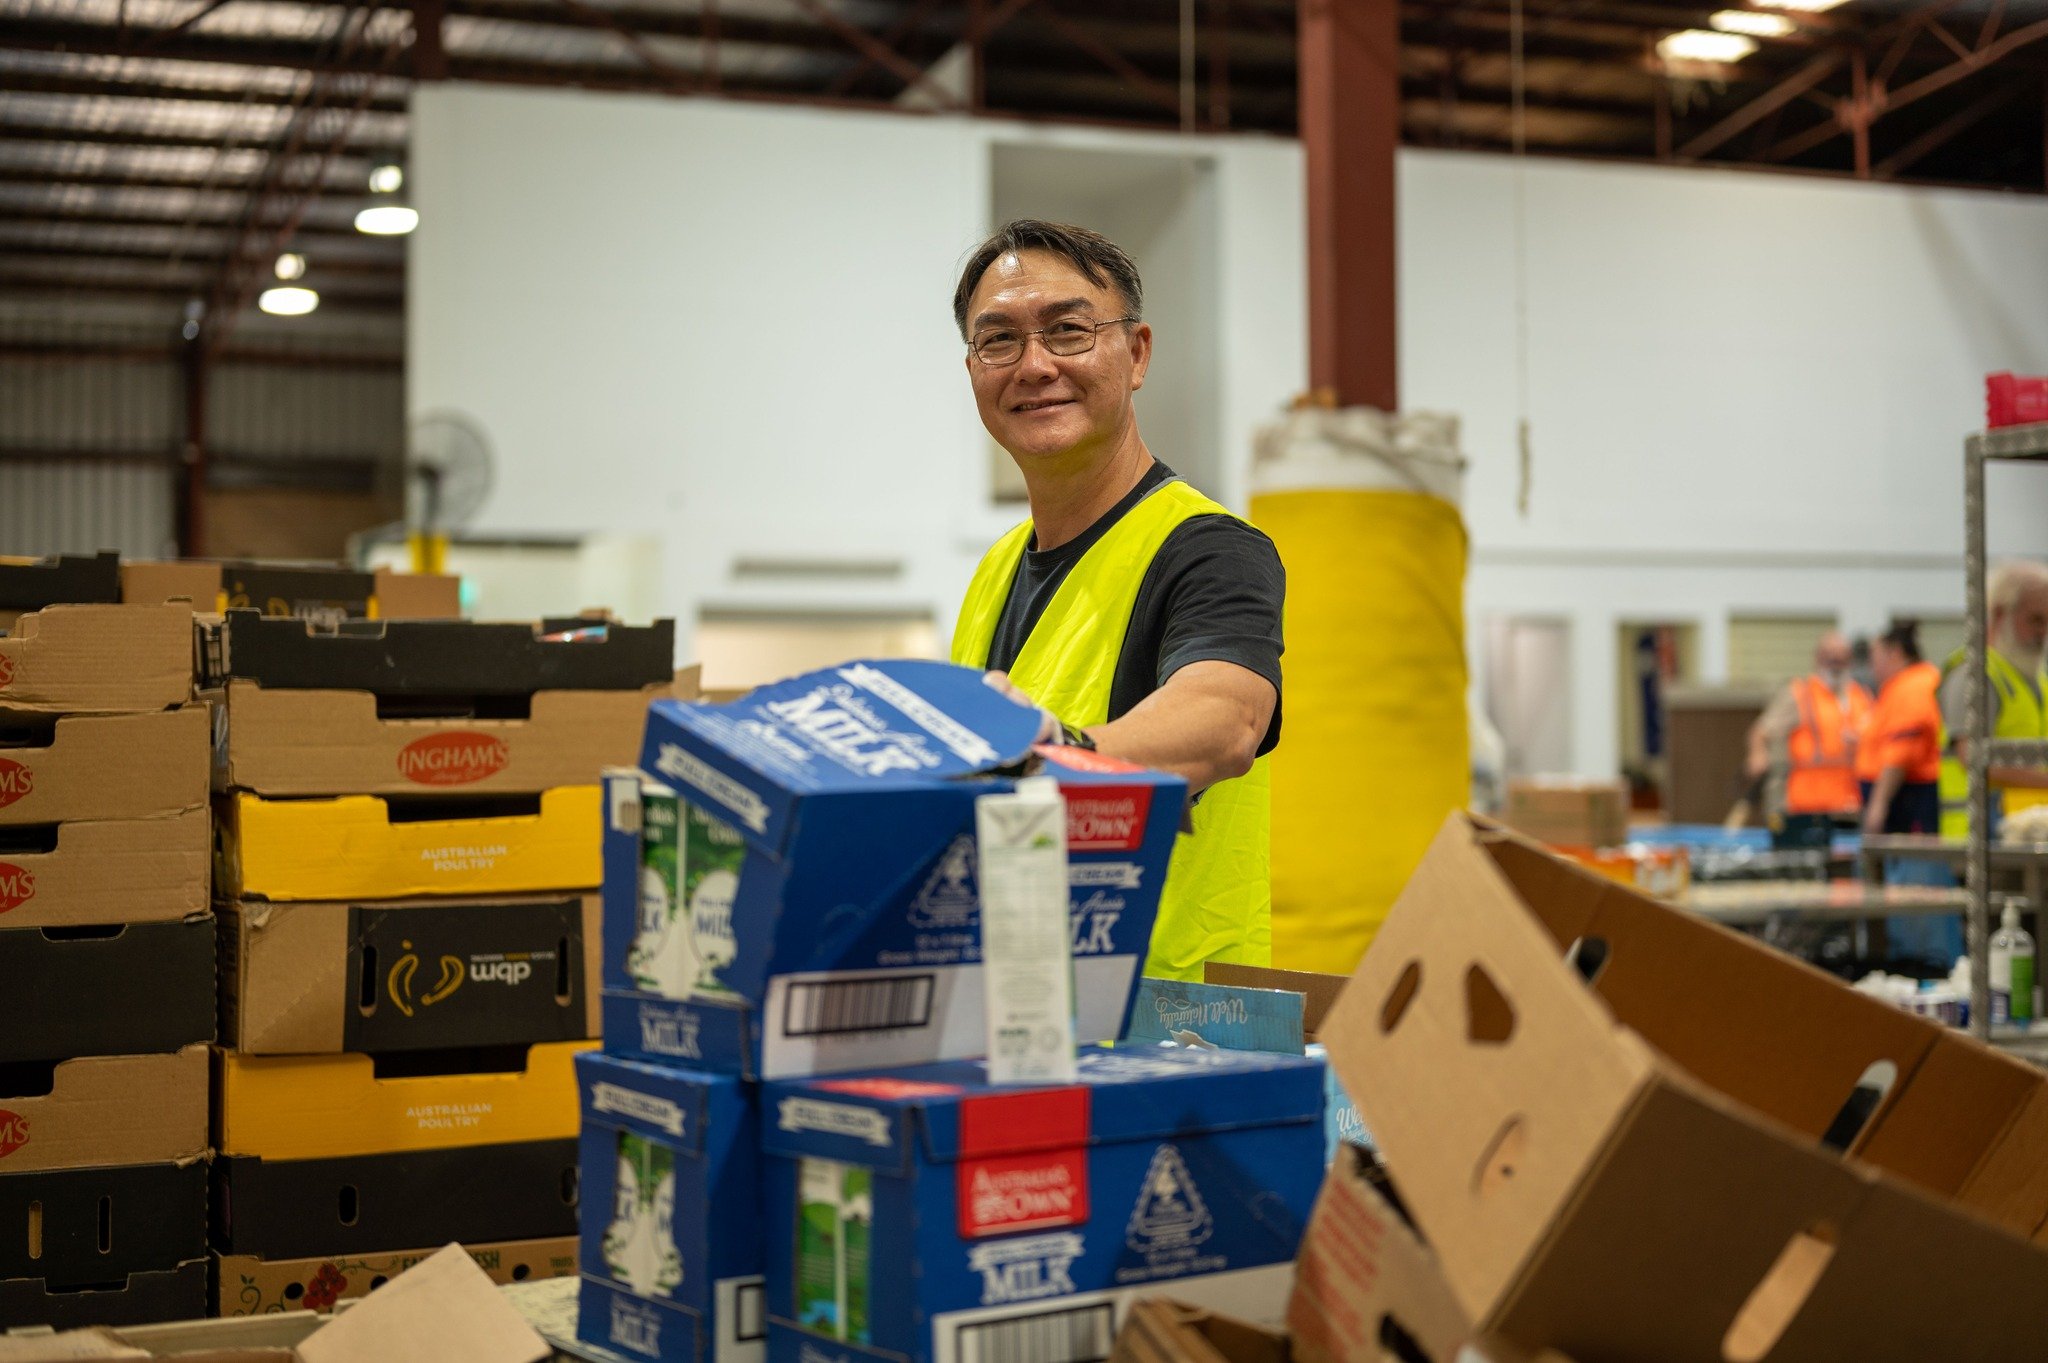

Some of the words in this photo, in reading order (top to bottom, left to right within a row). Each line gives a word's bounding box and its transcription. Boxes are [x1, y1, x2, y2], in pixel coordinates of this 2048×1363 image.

[767, 686, 920, 776] MILK
[400, 742, 509, 776] INGHAM'S
[421, 844, 507, 860] AUSTRALIAN
[433, 857, 494, 871] POULTRY
[1071, 912, 1121, 953] LK
[470, 961, 531, 984] dbm
[1155, 997, 1208, 1030] Naturally
[1209, 998, 1248, 1025] Well
[640, 1018, 701, 1059] MILK
[406, 1103, 493, 1118] AUSTRALIAN
[418, 1116, 481, 1129] POULTRY
[980, 1255, 1076, 1305] MILK
